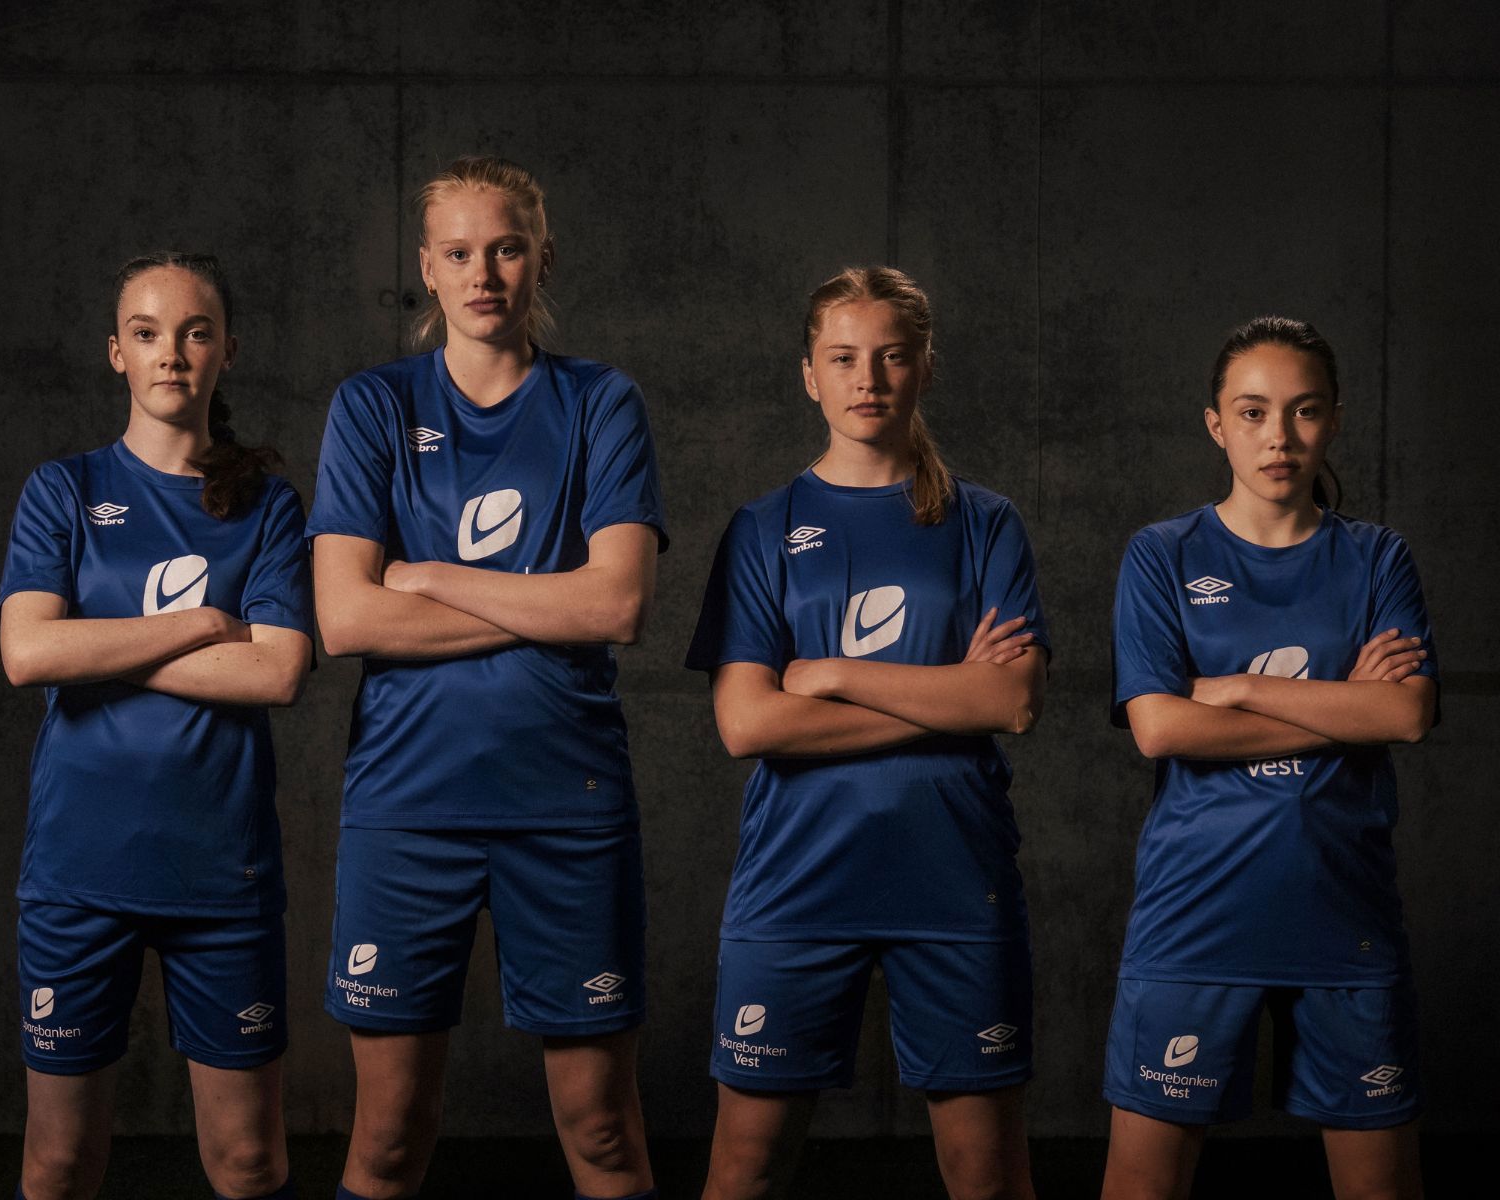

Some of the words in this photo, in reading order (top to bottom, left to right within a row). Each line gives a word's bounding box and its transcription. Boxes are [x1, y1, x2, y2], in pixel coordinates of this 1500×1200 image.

[409, 443, 439, 453] mbro
[787, 541, 823, 554] umbro
[1190, 595, 1230, 605] umbro
[346, 991, 371, 1008] Vest
[588, 993, 624, 1005] umbro
[240, 1022, 273, 1034] umbro
[33, 1036, 56, 1051] Vest
[719, 1032, 788, 1057] Sparebanken
[981, 1042, 1016, 1054] umbro
[734, 1052, 761, 1068] Vest
[1139, 1065, 1218, 1088] Sparebanken
[1163, 1083, 1190, 1099] Vest
[1366, 1084, 1402, 1097] umbro
